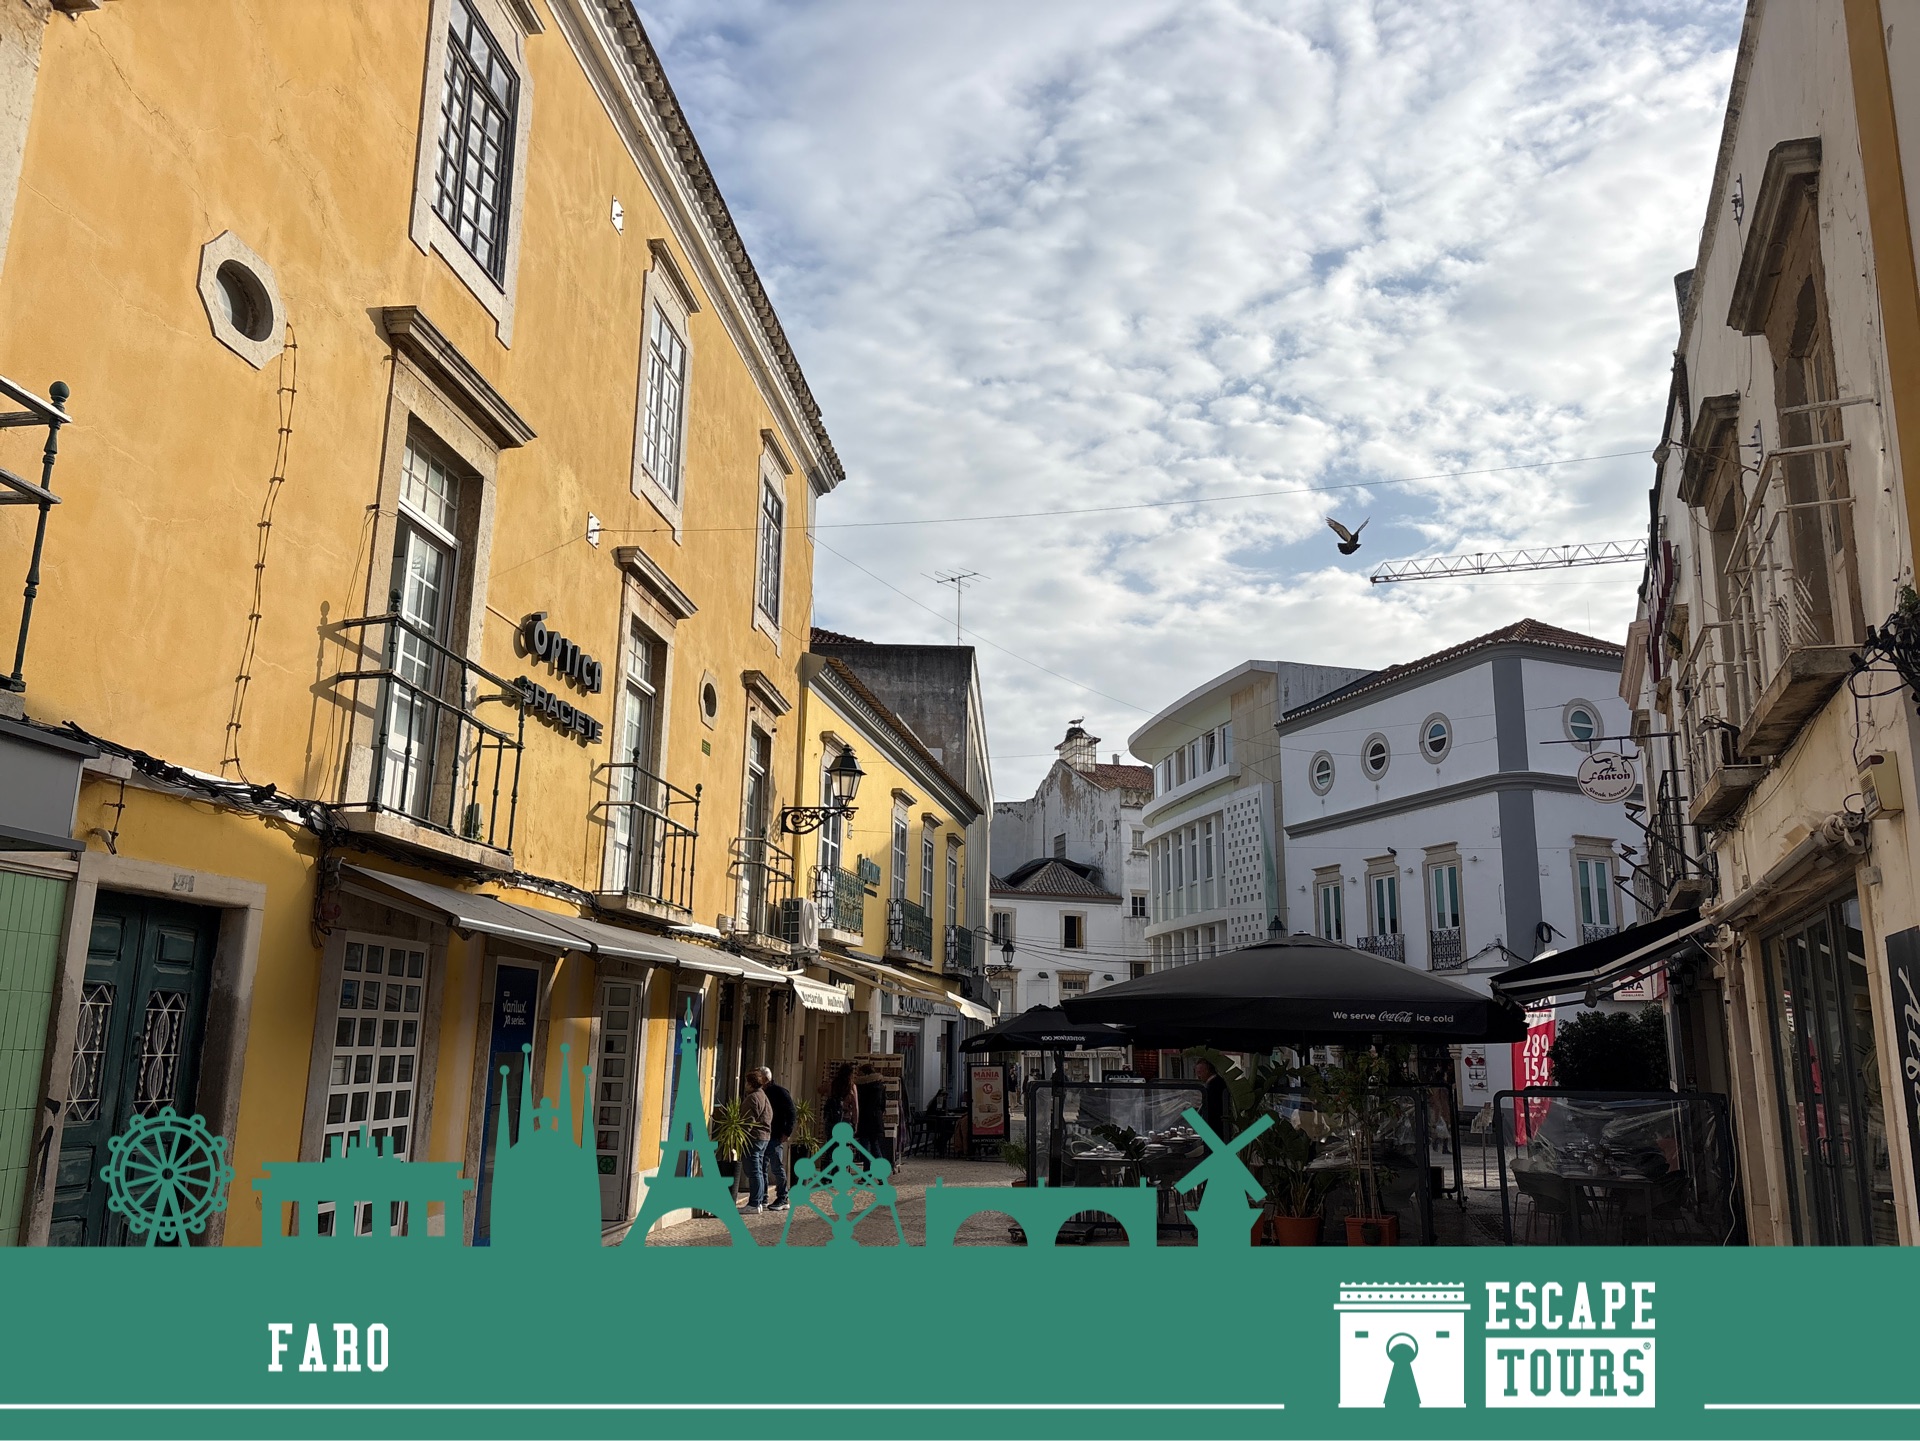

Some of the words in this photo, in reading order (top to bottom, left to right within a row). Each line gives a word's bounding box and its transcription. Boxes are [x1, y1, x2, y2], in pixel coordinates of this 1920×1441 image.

[1332, 1011, 1348, 1020] We
[1416, 1013, 1431, 1022] ice
[1433, 1014, 1455, 1023] cold
[1523, 1034, 1549, 1057] 289
[1524, 1057, 1549, 1081] 154
